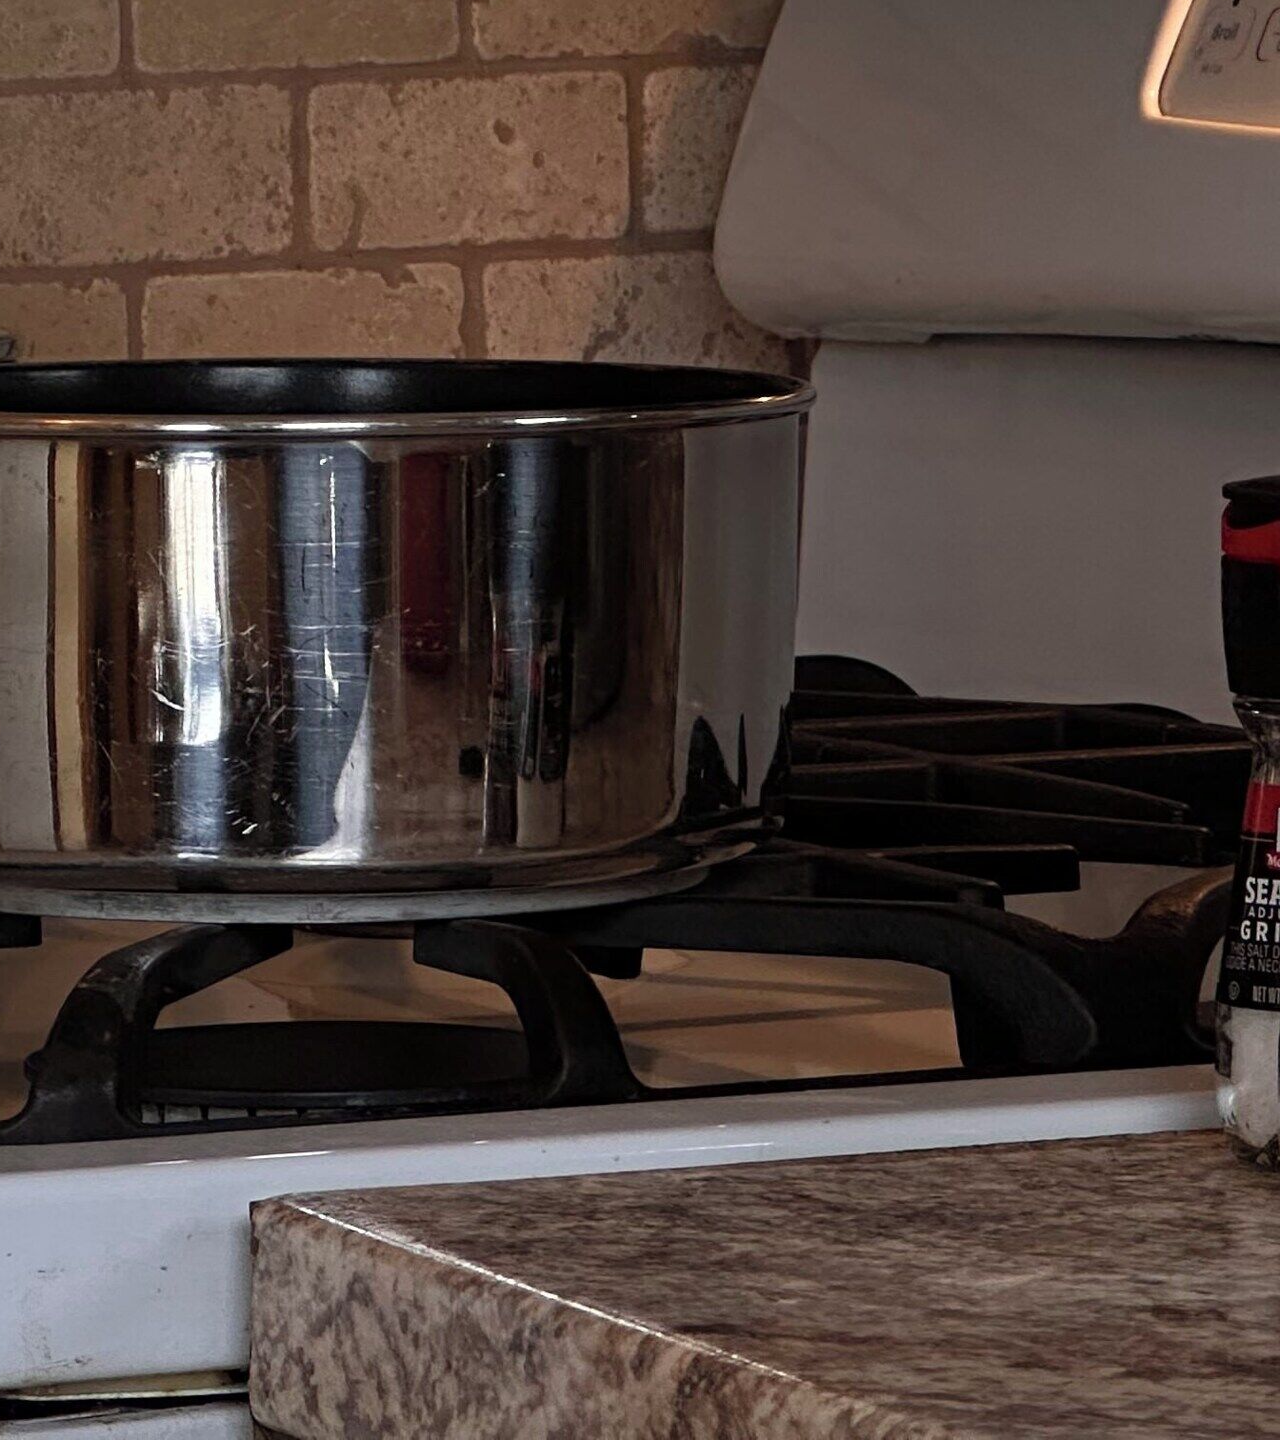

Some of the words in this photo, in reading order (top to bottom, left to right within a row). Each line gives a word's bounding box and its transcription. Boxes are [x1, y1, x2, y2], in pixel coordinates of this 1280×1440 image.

[1211, 22, 1240, 41] Broil
[1247, 942, 1269, 958] SALT
[1248, 958, 1256, 971] A
[1252, 985, 1267, 1003] NET
[1268, 987, 1280, 1004] WT
